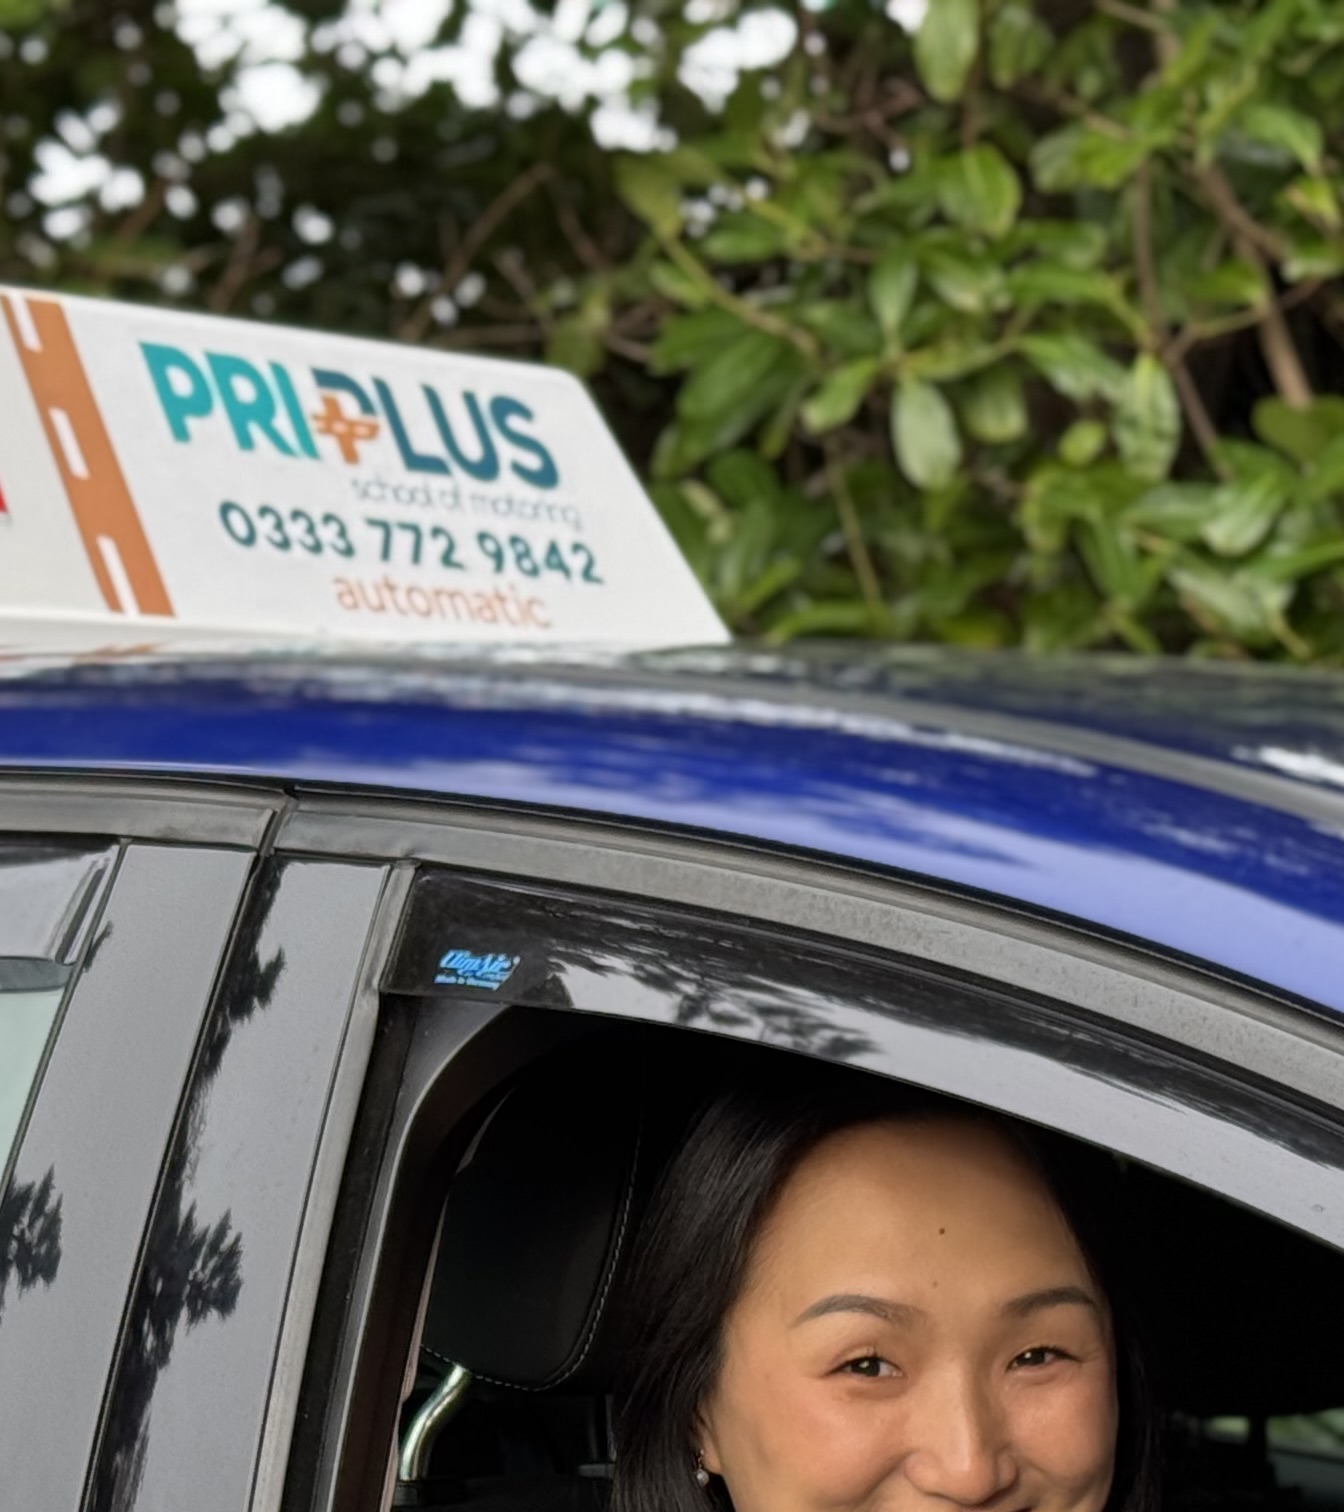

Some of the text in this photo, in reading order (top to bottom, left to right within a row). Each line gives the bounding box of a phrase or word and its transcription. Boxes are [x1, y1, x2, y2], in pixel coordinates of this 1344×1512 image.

[351, 473, 433, 508] school
[219, 500, 605, 585] 0333 772 9842
[331, 574, 552, 629] automatic
